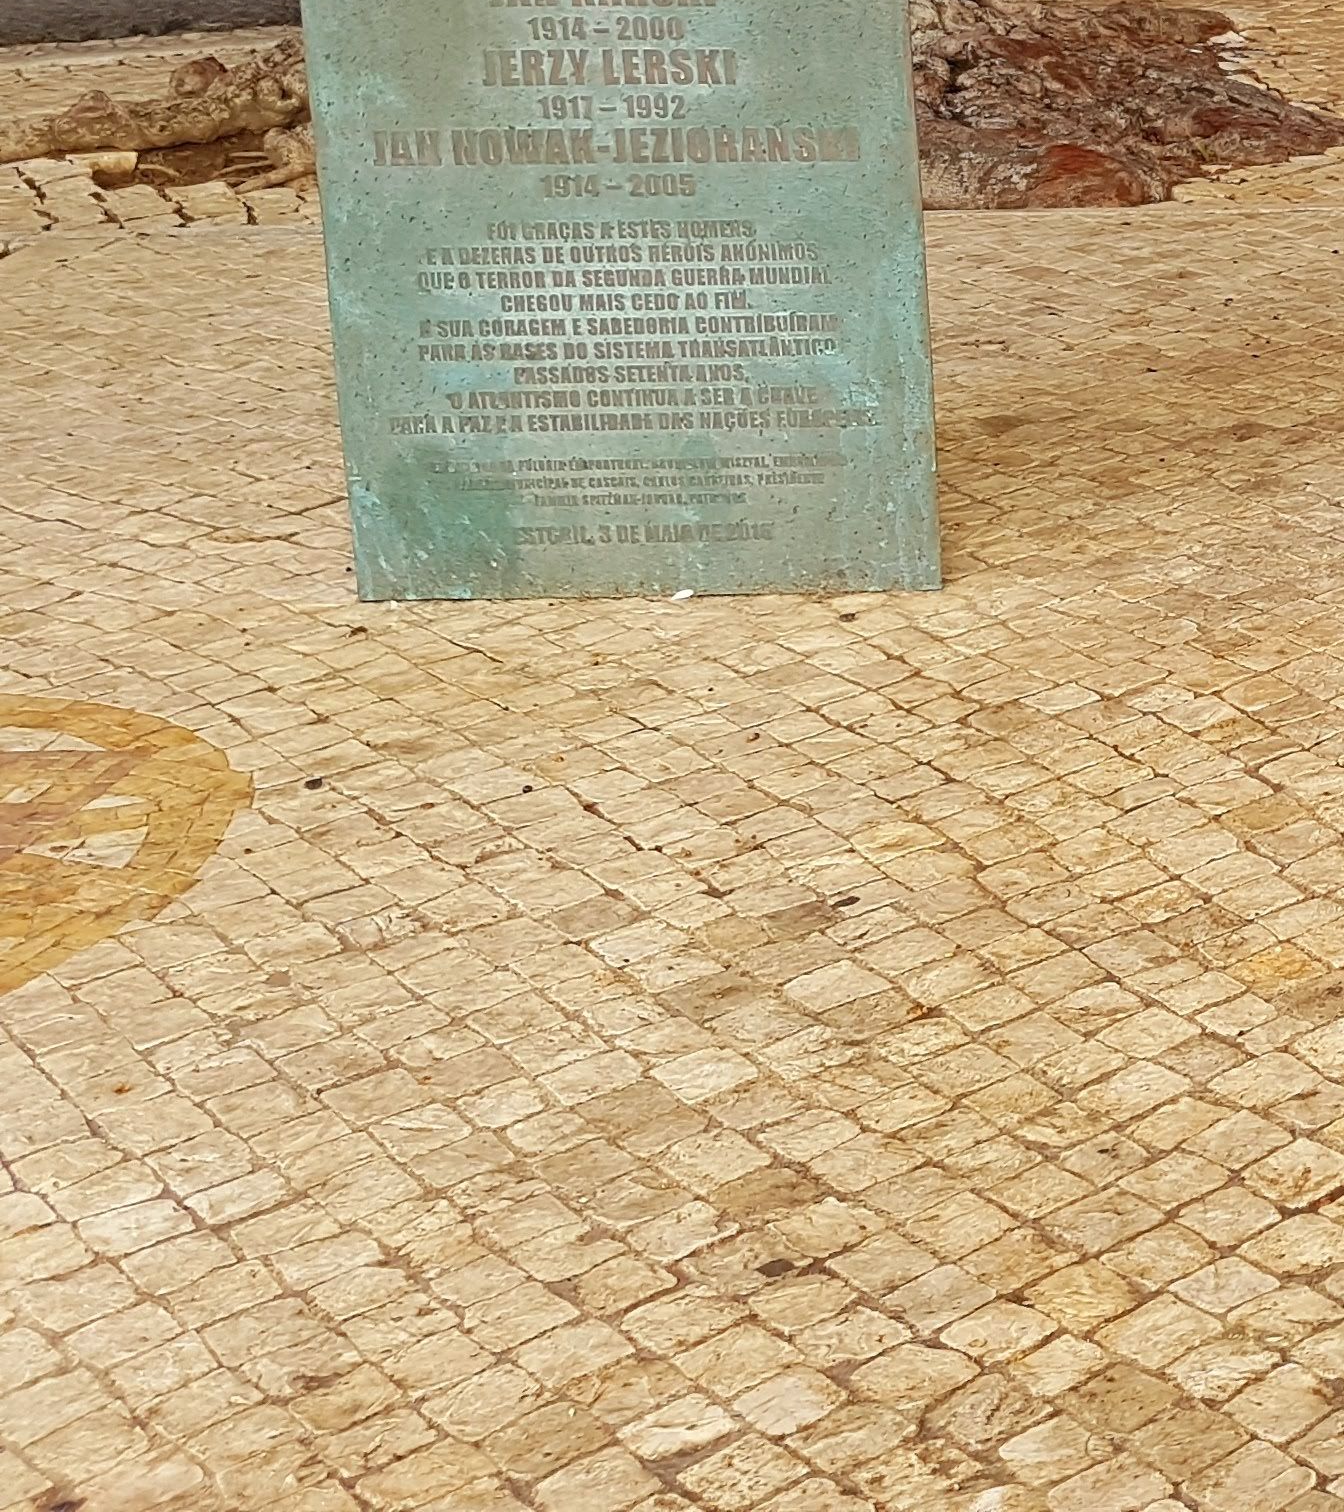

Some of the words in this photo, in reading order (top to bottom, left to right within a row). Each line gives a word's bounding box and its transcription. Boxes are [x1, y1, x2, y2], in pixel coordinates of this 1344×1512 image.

[528, 17, 588, 41] 1914
[615, 16, 686, 41] 2000
[482, 49, 590, 86] JERZY
[601, 48, 738, 86] LERSKI
[538, 95, 593, 120] 1917
[622, 94, 687, 119] 1992
[373, 129, 442, 167] JAN
[541, 174, 599, 198] 1914
[628, 173, 698, 198] 2005
[487, 221, 516, 241] FOI
[521, 221, 595, 243] GRAÇAS
[599, 220, 614, 240] A
[617, 220, 672, 239] ESTES
[426, 247, 437, 266] E
[441, 247, 454, 266] A
[458, 245, 538, 266] DEZENAS
[542, 245, 565, 264] DE
[569, 243, 643, 264] OUTROS
[648, 240, 715, 263] HERÓIS
[720, 239, 820, 263] ANÓNIMOS
[417, 271, 455, 291] QUE
[458, 271, 472, 290] O
[475, 270, 547, 290] TERROR
[552, 270, 577, 289] DA
[582, 268, 667, 288] SEGUNDA
[671, 266, 746, 287] GUERRA
[750, 266, 833, 286] MUNDIAL
[500, 294, 574, 313] CHEGOU
[579, 293, 627, 312] MAIS
[630, 292, 680, 311] CEDO
[684, 292, 709, 311] AO
[436, 319, 475, 338] SUA
[478, 318, 568, 338] CORAGEM
[572, 317, 583, 337] E
[586, 317, 690, 336] SABEDORIA
[416, 343, 467, 363] PARA
[470, 343, 497, 362] AS
[500, 342, 558, 361] BASES
[563, 341, 588, 360] DO
[592, 340, 675, 360] SISTEMA
[513, 365, 609, 386] PASSADOS
[612, 364, 694, 385] SETENTA
[467, 390, 581, 410] ATLANTISMO
[586, 388, 679, 408] CONTINUA
[682, 387, 697, 407] A
[701, 387, 735, 406] SER
[441, 415, 455, 433] A
[458, 414, 492, 434] PAZ
[657, 411, 695, 431] DAS
[699, 407, 771, 432] NAÇÕES
[599, 524, 612, 544] 3
[616, 524, 639, 544] DE
